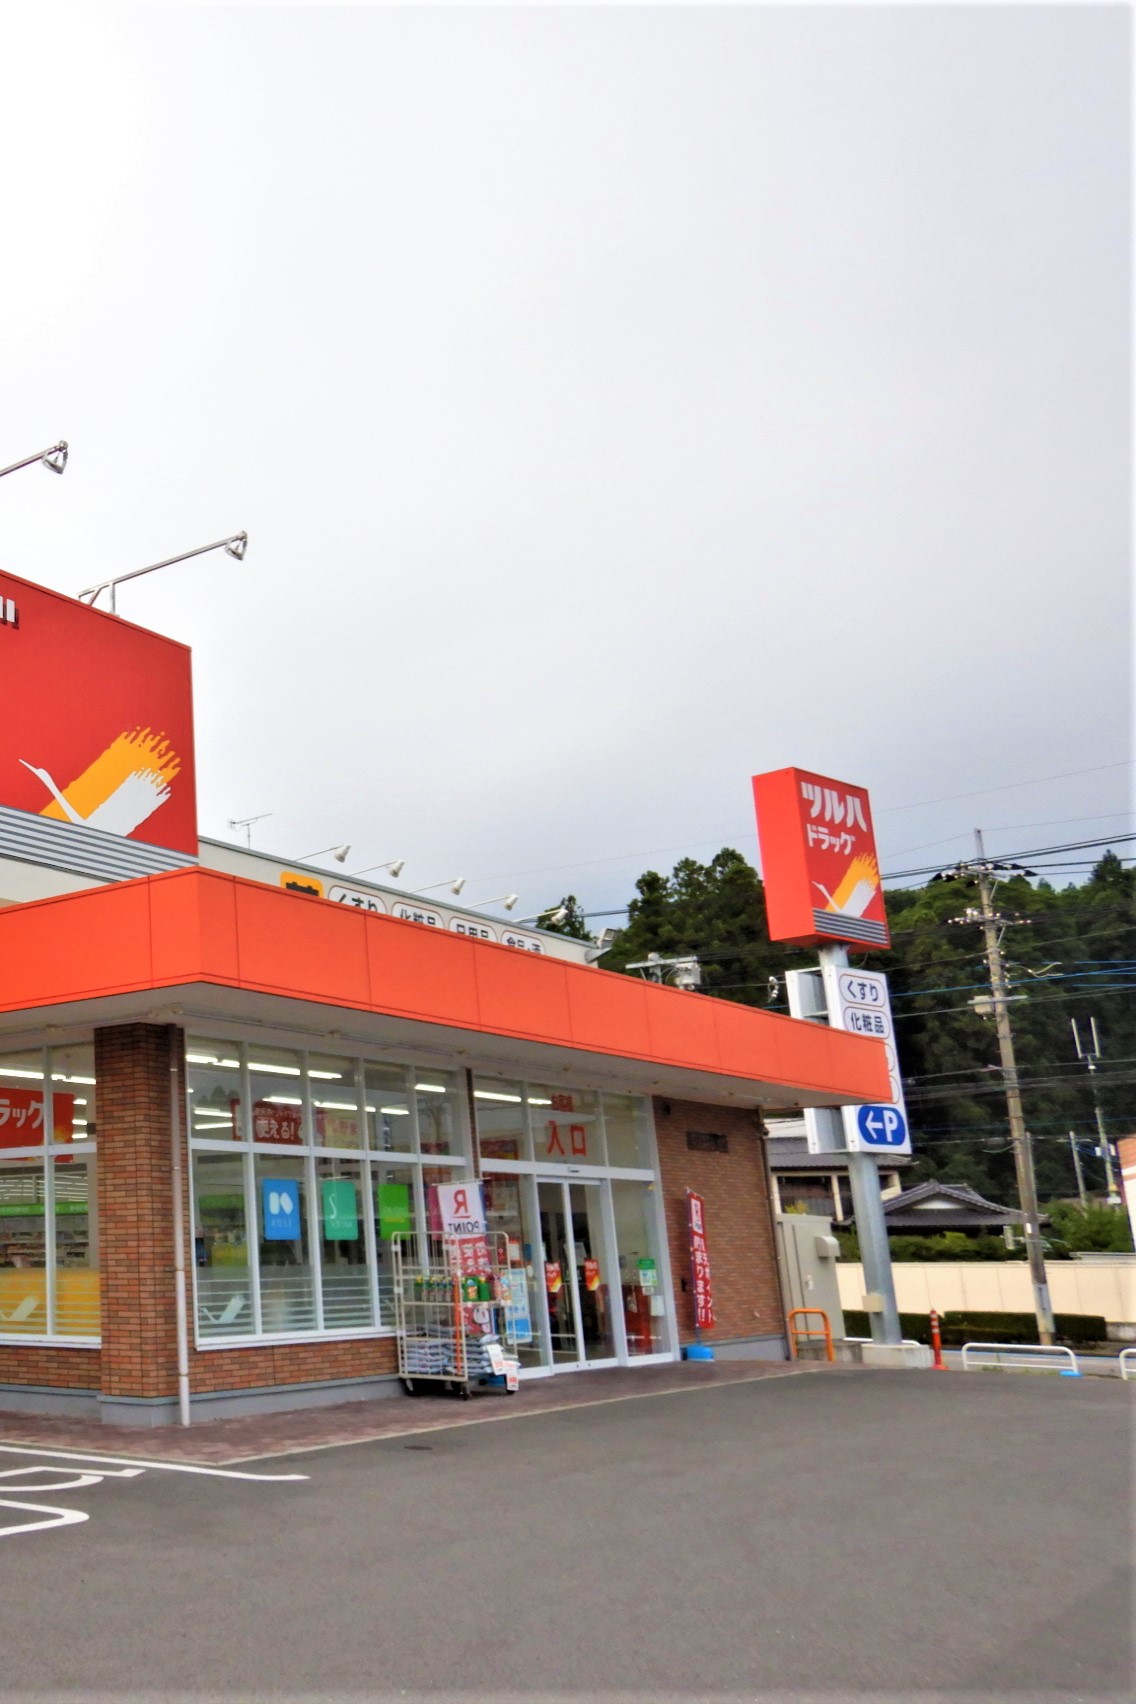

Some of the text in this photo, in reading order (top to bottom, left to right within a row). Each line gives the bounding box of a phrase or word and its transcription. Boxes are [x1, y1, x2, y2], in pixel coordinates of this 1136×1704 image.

[800, 780, 867, 833] ツルハ
[806, 823, 855, 856] ドラッグ
[846, 980, 879, 1002] くすり
[850, 1010, 885, 1035] 化粧品
[547, 1120, 587, 1156] 入口
[885, 1114, 898, 1142] P
